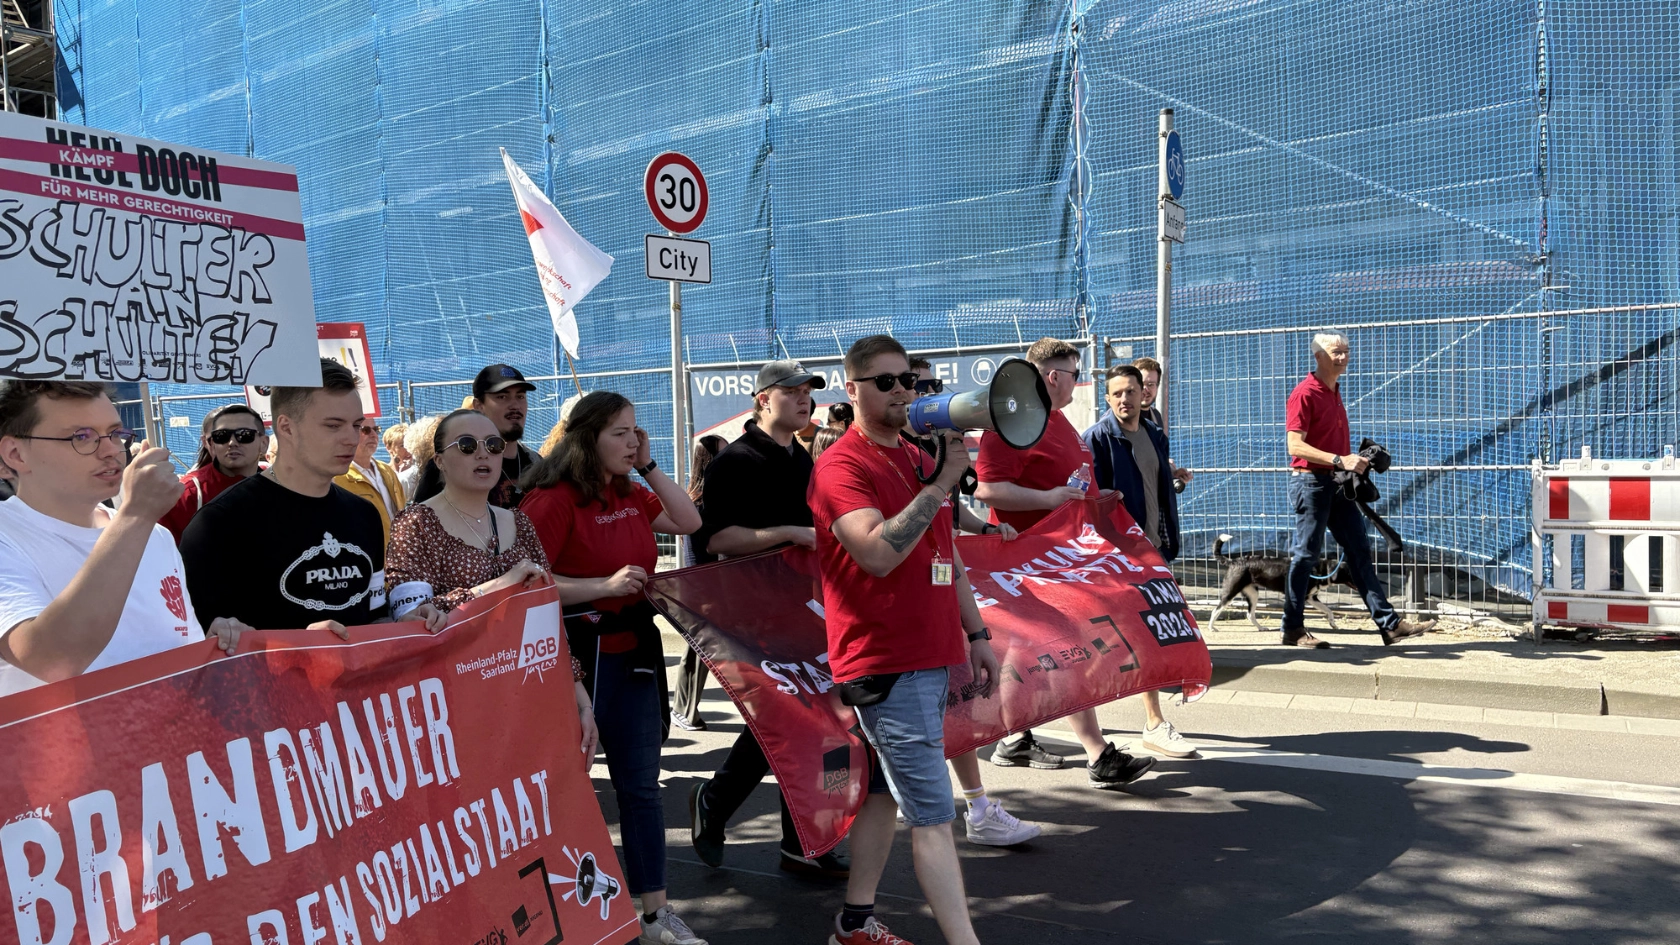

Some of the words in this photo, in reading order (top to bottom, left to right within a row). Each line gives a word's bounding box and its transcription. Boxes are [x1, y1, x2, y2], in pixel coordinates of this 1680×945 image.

[59, 147, 114, 168] KÄMPF
[136, 143, 221, 202] DOCH
[40, 179, 72, 197] FÜR
[76, 187, 120, 206] MEHR
[123, 196, 234, 225] GERECHTIGKEIT
[659, 173, 696, 213] 30
[659, 247, 699, 277] City
[305, 565, 363, 585] PRADA
[324, 581, 349, 591] MILANO
[1147, 611, 1193, 640] 2026
[455, 648, 518, 675] Rheinland-Pfalz
[523, 636, 557, 664] DGB
[480, 661, 516, 680] Saarland
[826, 767, 849, 787] DGB
[0, 677, 461, 945] BRANDMAUER
[356, 769, 553, 943] SOZIALSTAAT
